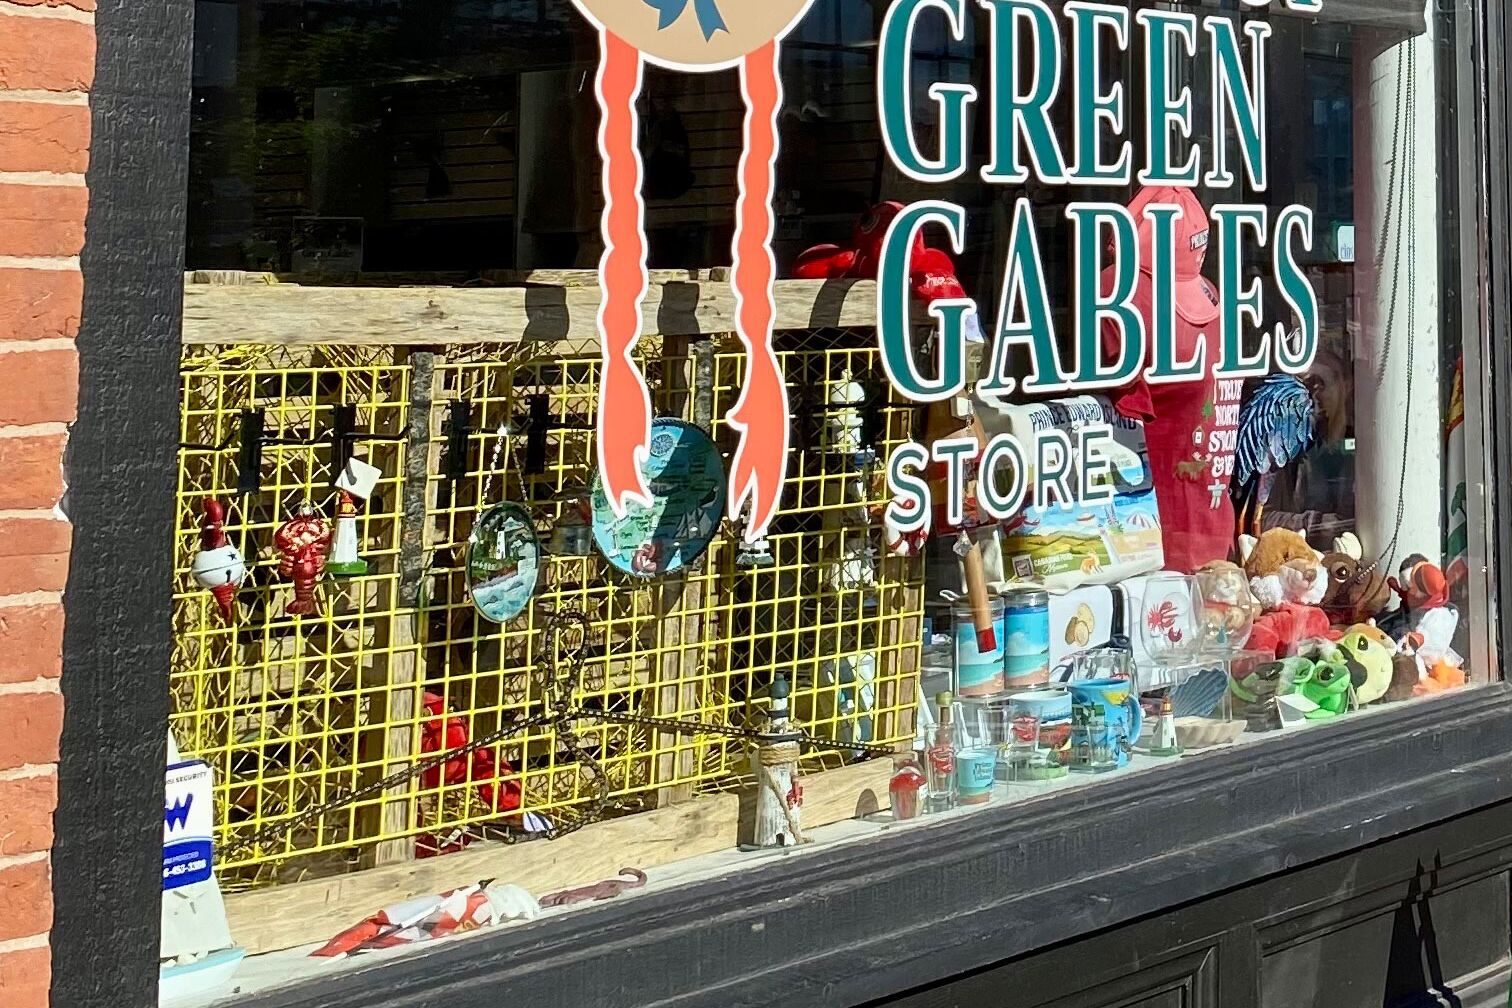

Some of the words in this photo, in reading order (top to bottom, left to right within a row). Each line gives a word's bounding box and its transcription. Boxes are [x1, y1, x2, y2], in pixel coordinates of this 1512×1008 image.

[876, 198, 1320, 403] GABLES
[1218, 379, 1244, 401] TRUE
[1028, 405, 1063, 433] PRINCE
[885, 424, 1115, 527] STORE
[175, 771, 207, 784] SECURITY
